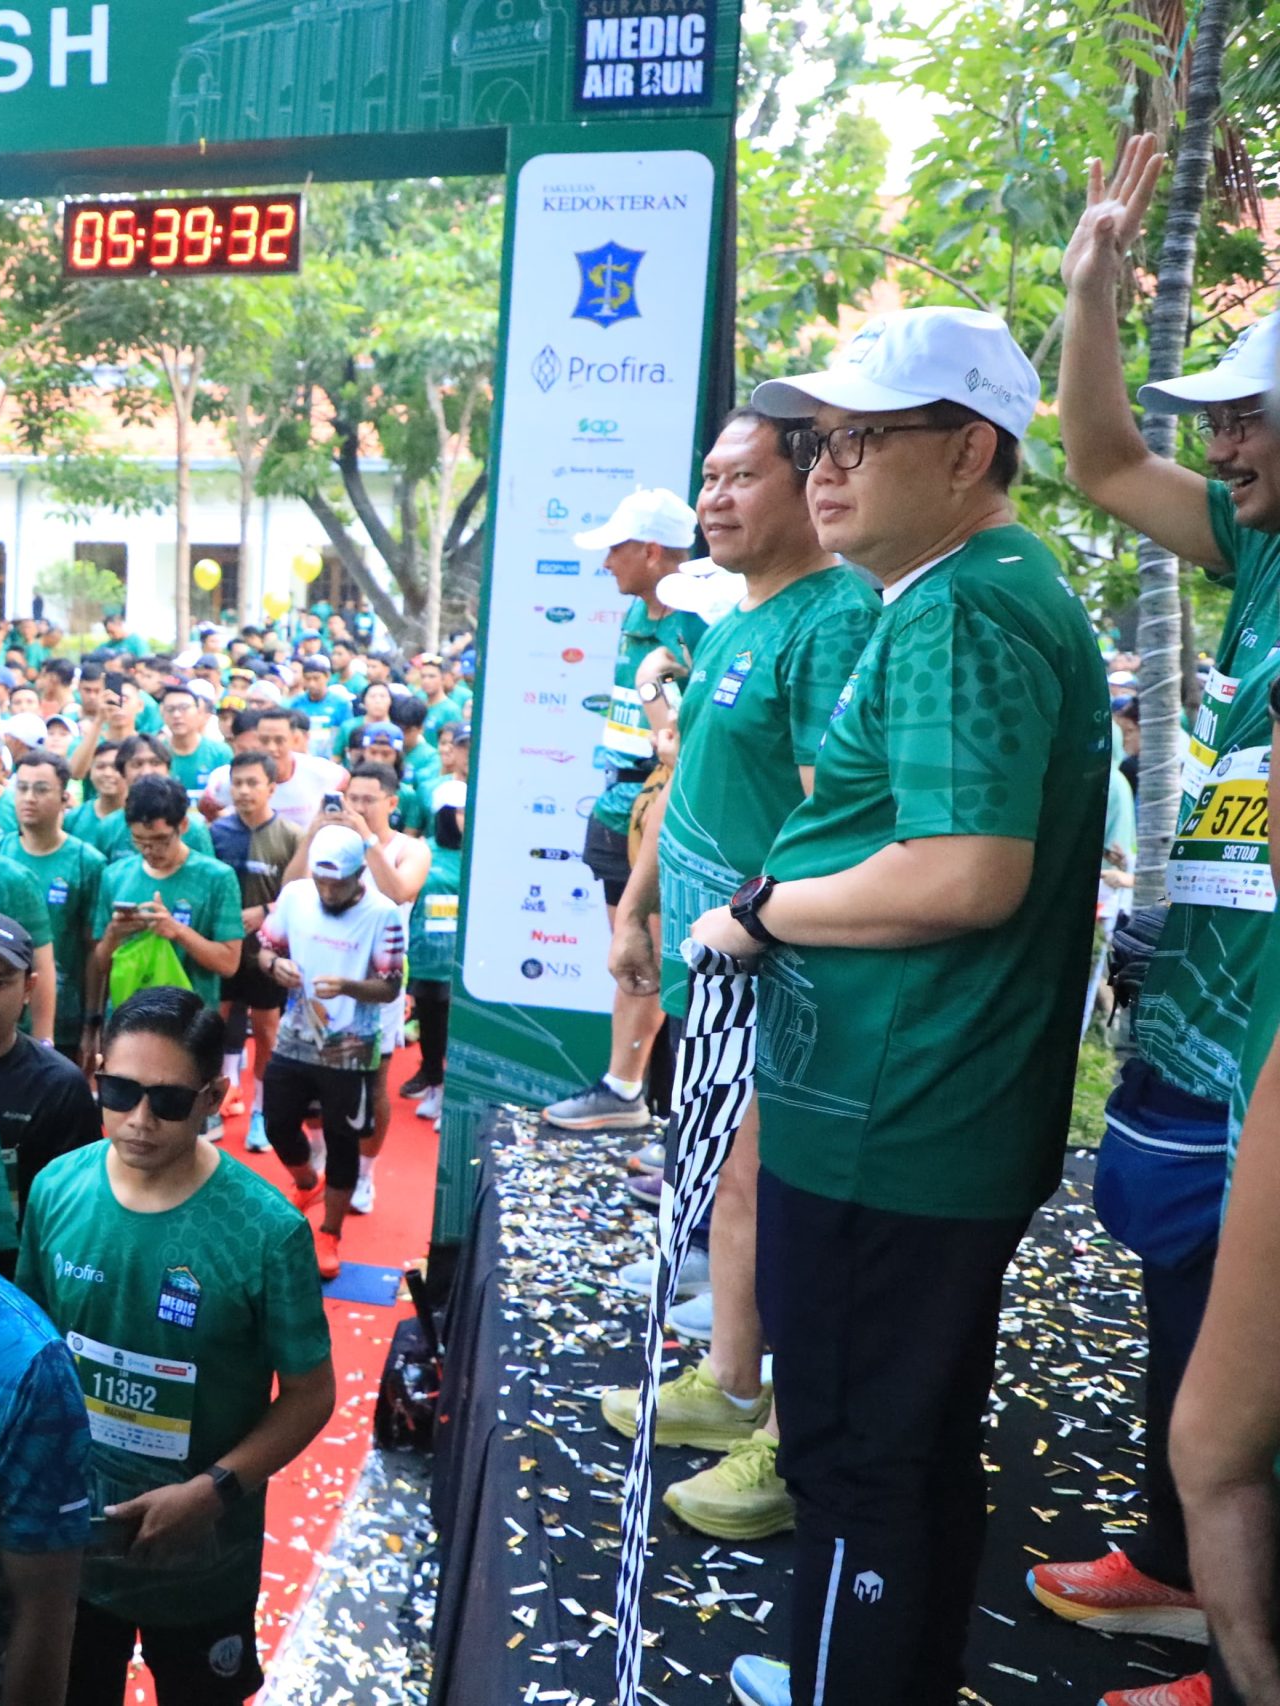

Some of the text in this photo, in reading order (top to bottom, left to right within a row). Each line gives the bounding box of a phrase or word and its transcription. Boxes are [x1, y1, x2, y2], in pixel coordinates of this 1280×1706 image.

[585, 13, 706, 61] MEDIC
[582, 60, 705, 98] AIR RUN
[542, 194, 689, 212] KEDOKTERAN
[71, 203, 294, 270] 05:39:32
[569, 356, 666, 384] Profira
[539, 692, 567, 705] BNI
[1222, 844, 1260, 861] SOETOJO
[64, 1261, 105, 1283] Profira
[160, 1294, 197, 1316] MEDIC
[93, 1372, 157, 1412] 11352
